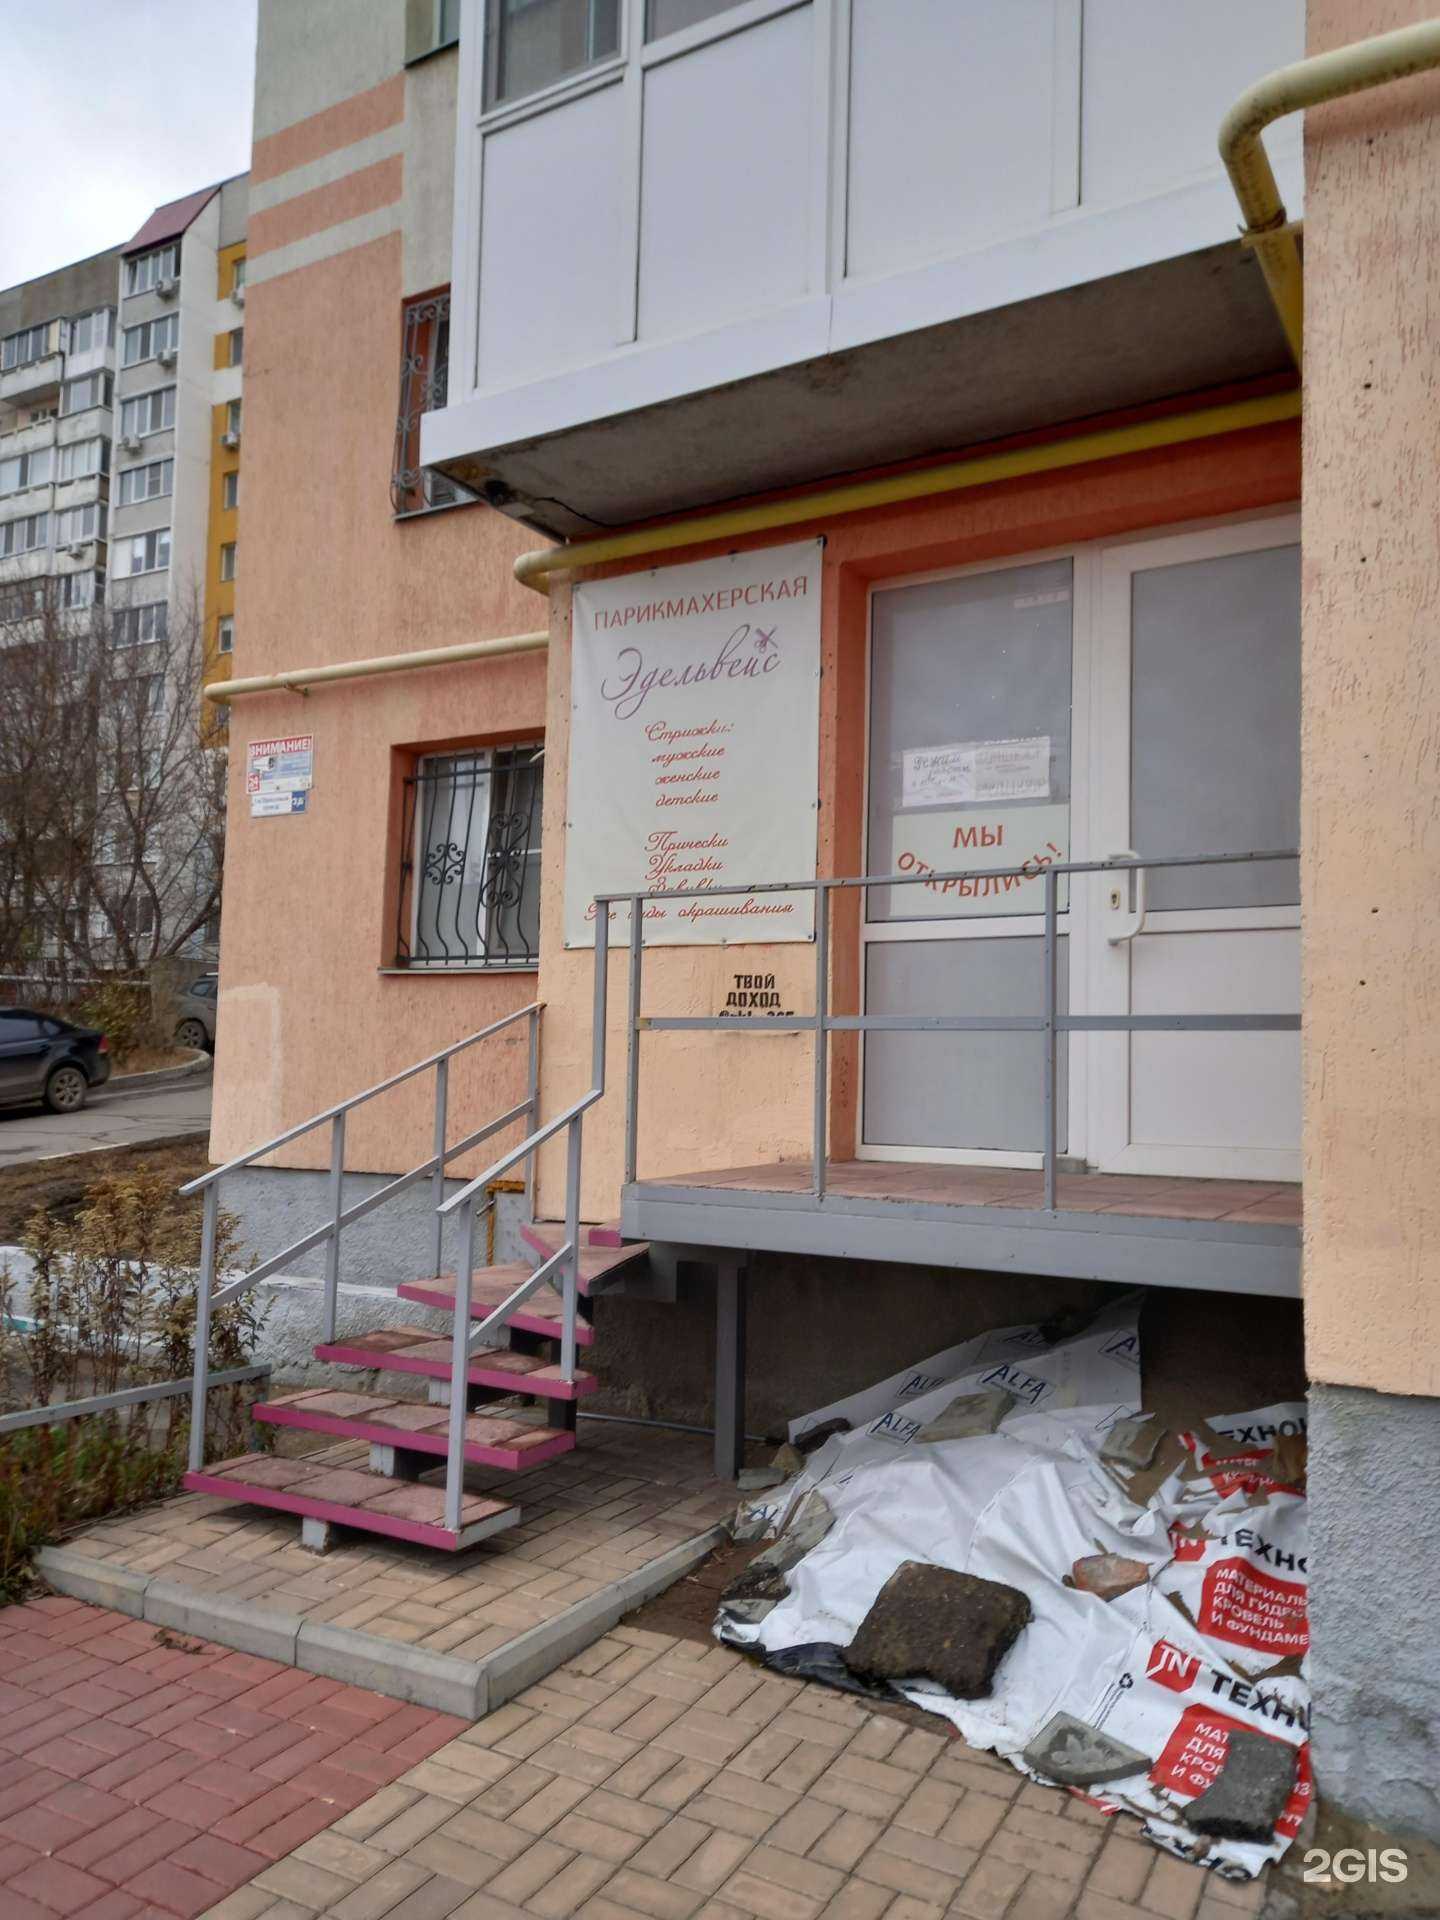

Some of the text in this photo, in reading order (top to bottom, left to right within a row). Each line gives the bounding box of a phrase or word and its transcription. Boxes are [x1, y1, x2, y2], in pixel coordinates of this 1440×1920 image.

[594, 576, 808, 631] ПАРИКМАХЕРСКАЯ
[651, 743, 725, 768] мужские
[655, 766, 721, 785] женские
[655, 789, 719, 808] детские
[644, 830, 729, 855] Прически
[953, 825, 1004, 848] МЫ
[645, 854, 725, 881] Укладки
[678, 899, 795, 922] окрашивания
[734, 973, 776, 989] ТВОЙ
[726, 992, 781, 1008] ДОХОД
[982, 1364, 1047, 1404] ALFA
[871, 1412, 922, 1445] ALFA
[1214, 1582, 1246, 1604] ДЛЯ
[1211, 1611, 1223, 1626] И
[1213, 1596, 1284, 1629] КРОВЕЛЬ
[1186, 1737, 1226, 1760] ДЛЯ
[1171, 1764, 1187, 1777] И
